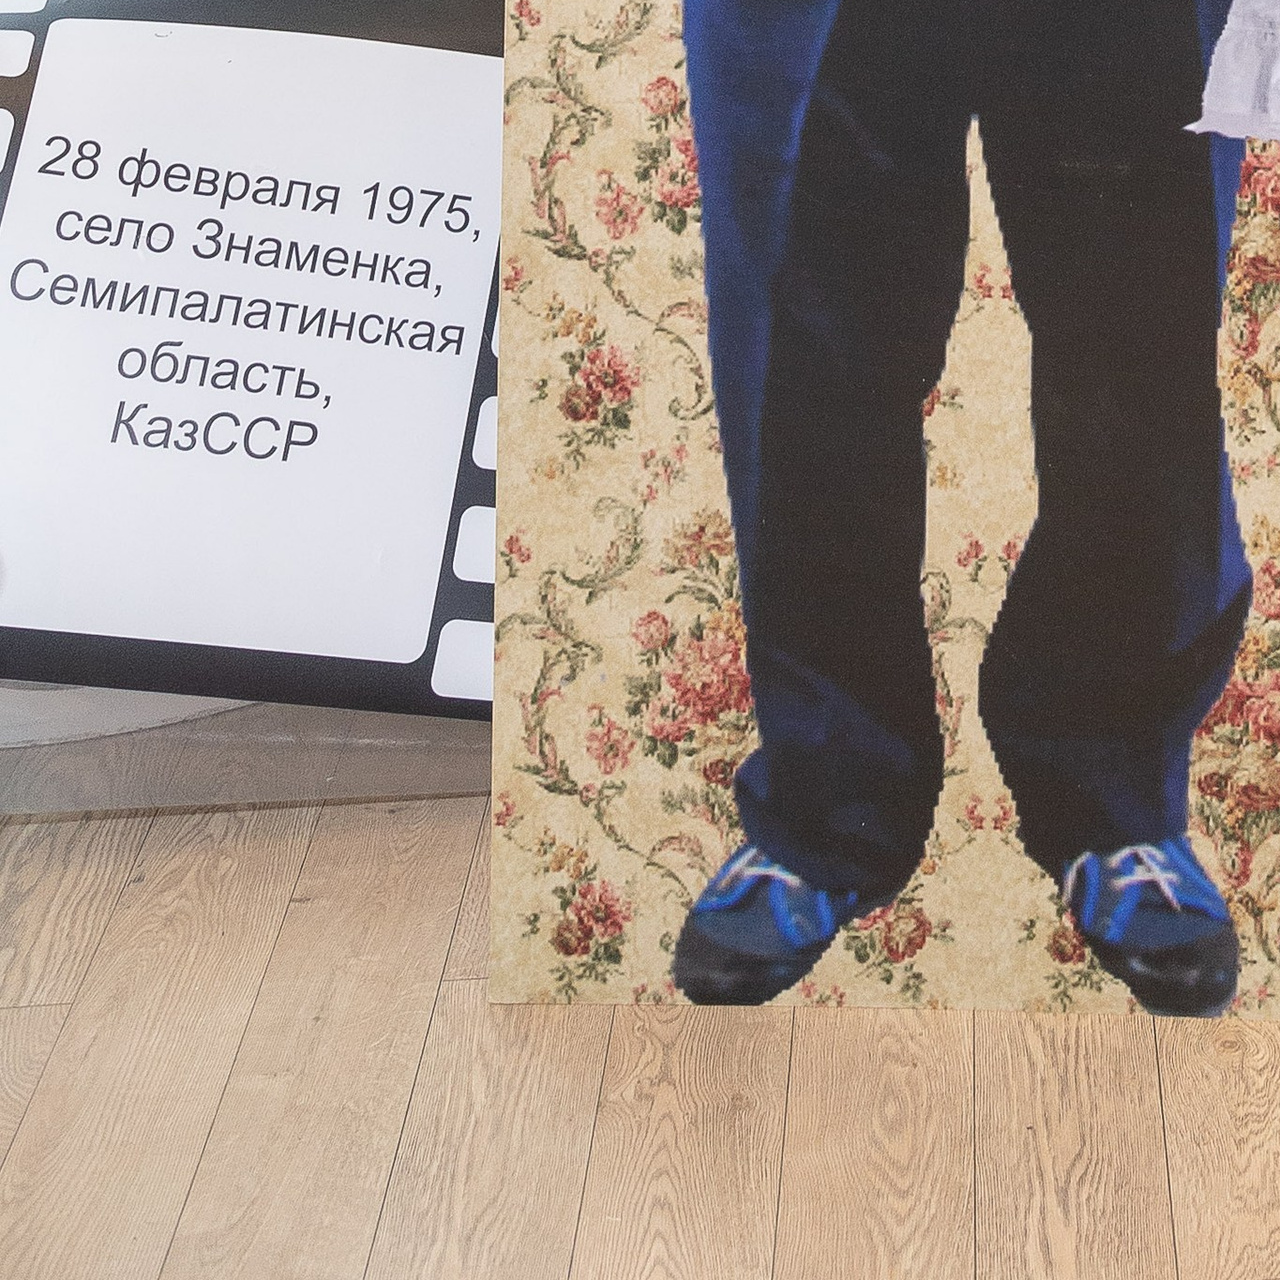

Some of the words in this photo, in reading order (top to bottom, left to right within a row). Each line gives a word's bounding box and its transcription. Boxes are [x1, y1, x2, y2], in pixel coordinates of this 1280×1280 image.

[36, 135, 102, 180] 28
[117, 147, 341, 215] февраля
[362, 181, 481, 243] 1975,
[54, 209, 175, 254] село
[191, 217, 443, 298] Знаменка,
[9, 257, 466, 356] Семипалатинская
[117, 340, 332, 410] область,
[109, 400, 319, 462] КазССР
